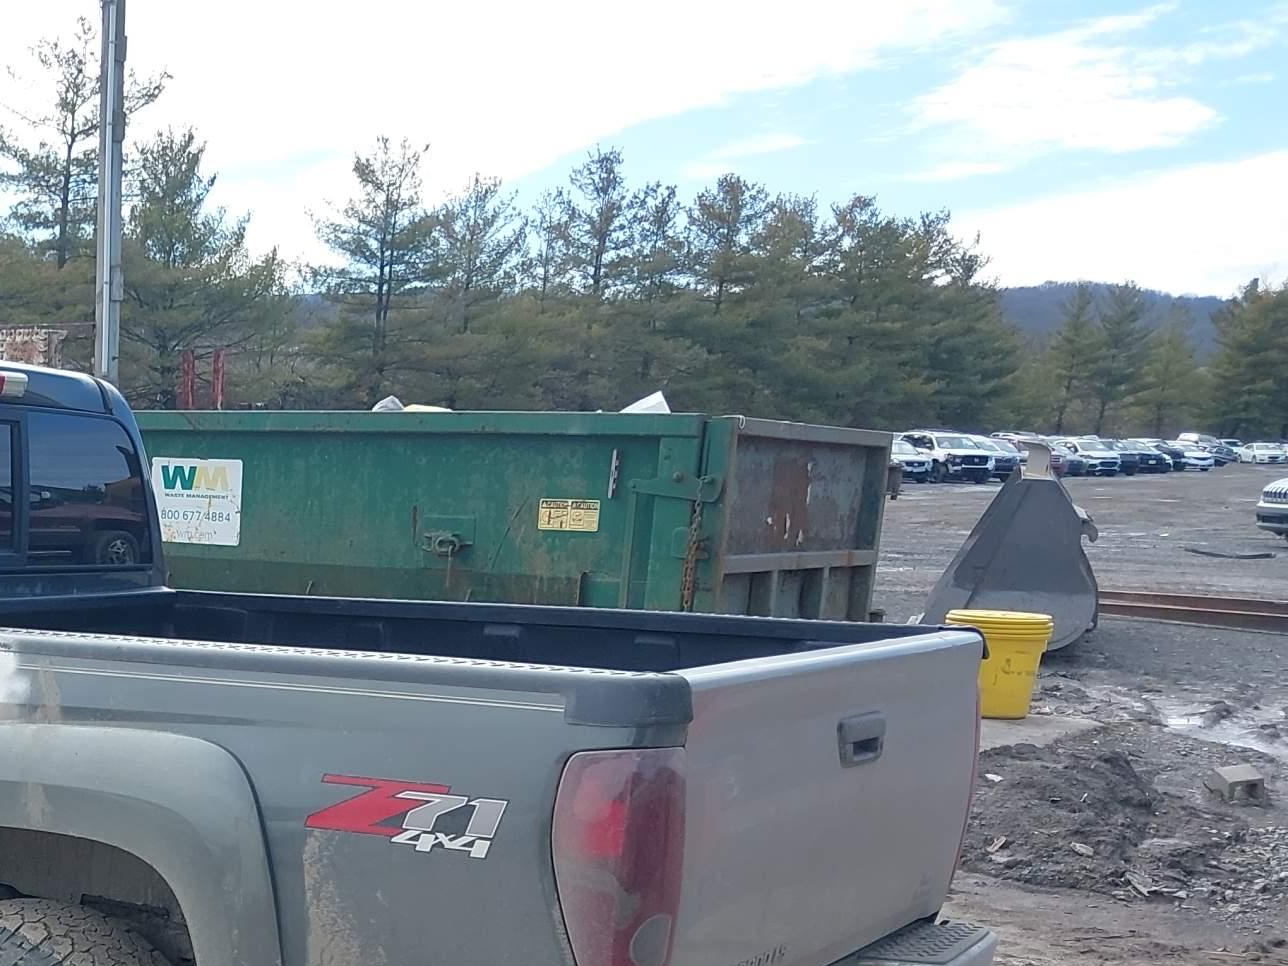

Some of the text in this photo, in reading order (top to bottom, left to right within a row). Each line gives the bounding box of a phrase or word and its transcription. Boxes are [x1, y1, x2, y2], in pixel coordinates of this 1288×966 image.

[161, 465, 230, 492] WM
[577, 502, 598, 510] CAUTION
[161, 510, 231, 522] 800 677 4884
[304, 773, 510, 838] Z71
